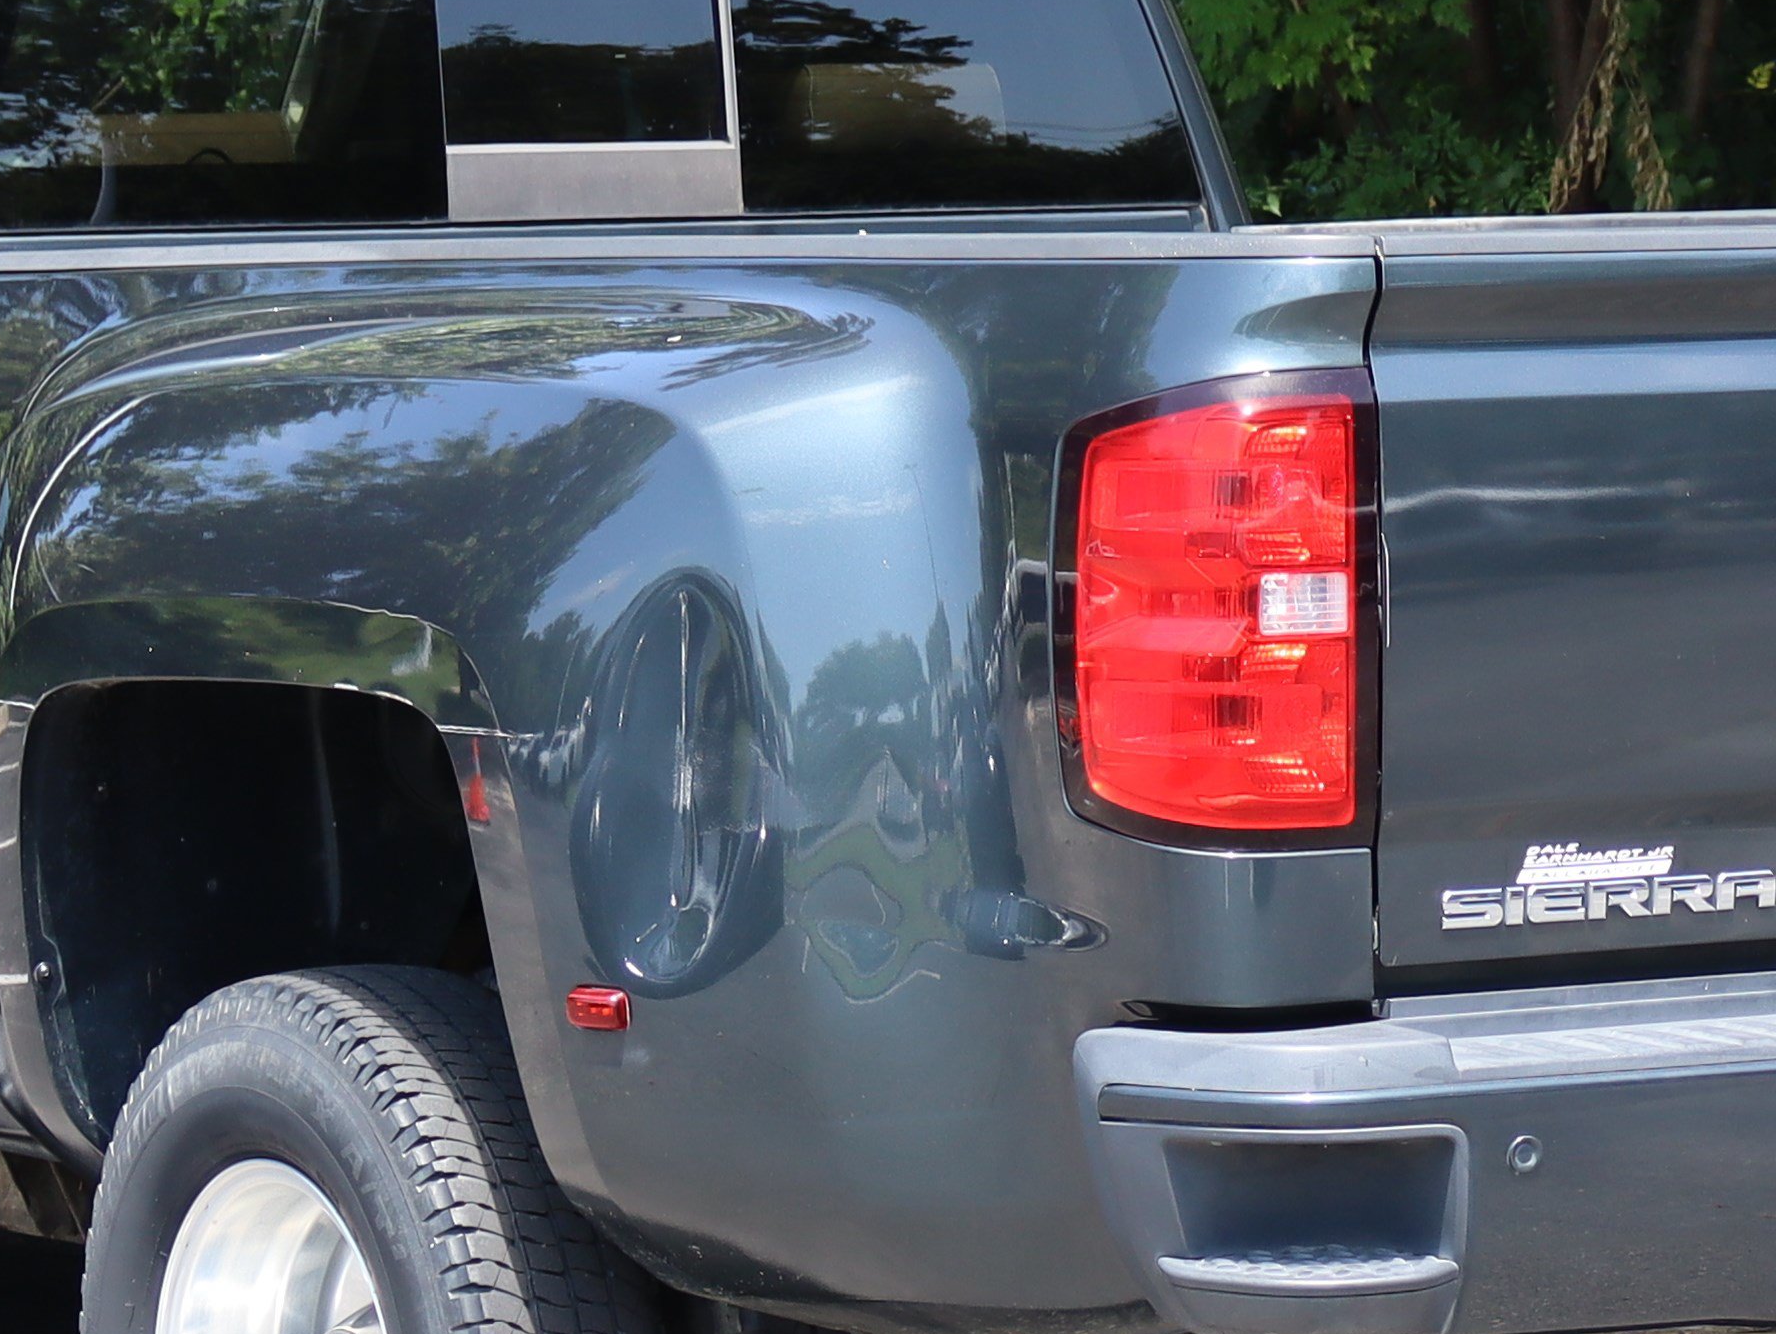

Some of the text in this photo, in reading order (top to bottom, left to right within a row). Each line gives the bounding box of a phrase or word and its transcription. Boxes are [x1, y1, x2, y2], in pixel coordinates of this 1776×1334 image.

[1523, 848, 1644, 867] EARNHARDT
[1526, 842, 1580, 856] DALE
[1441, 869, 1776, 931] SIERRA
